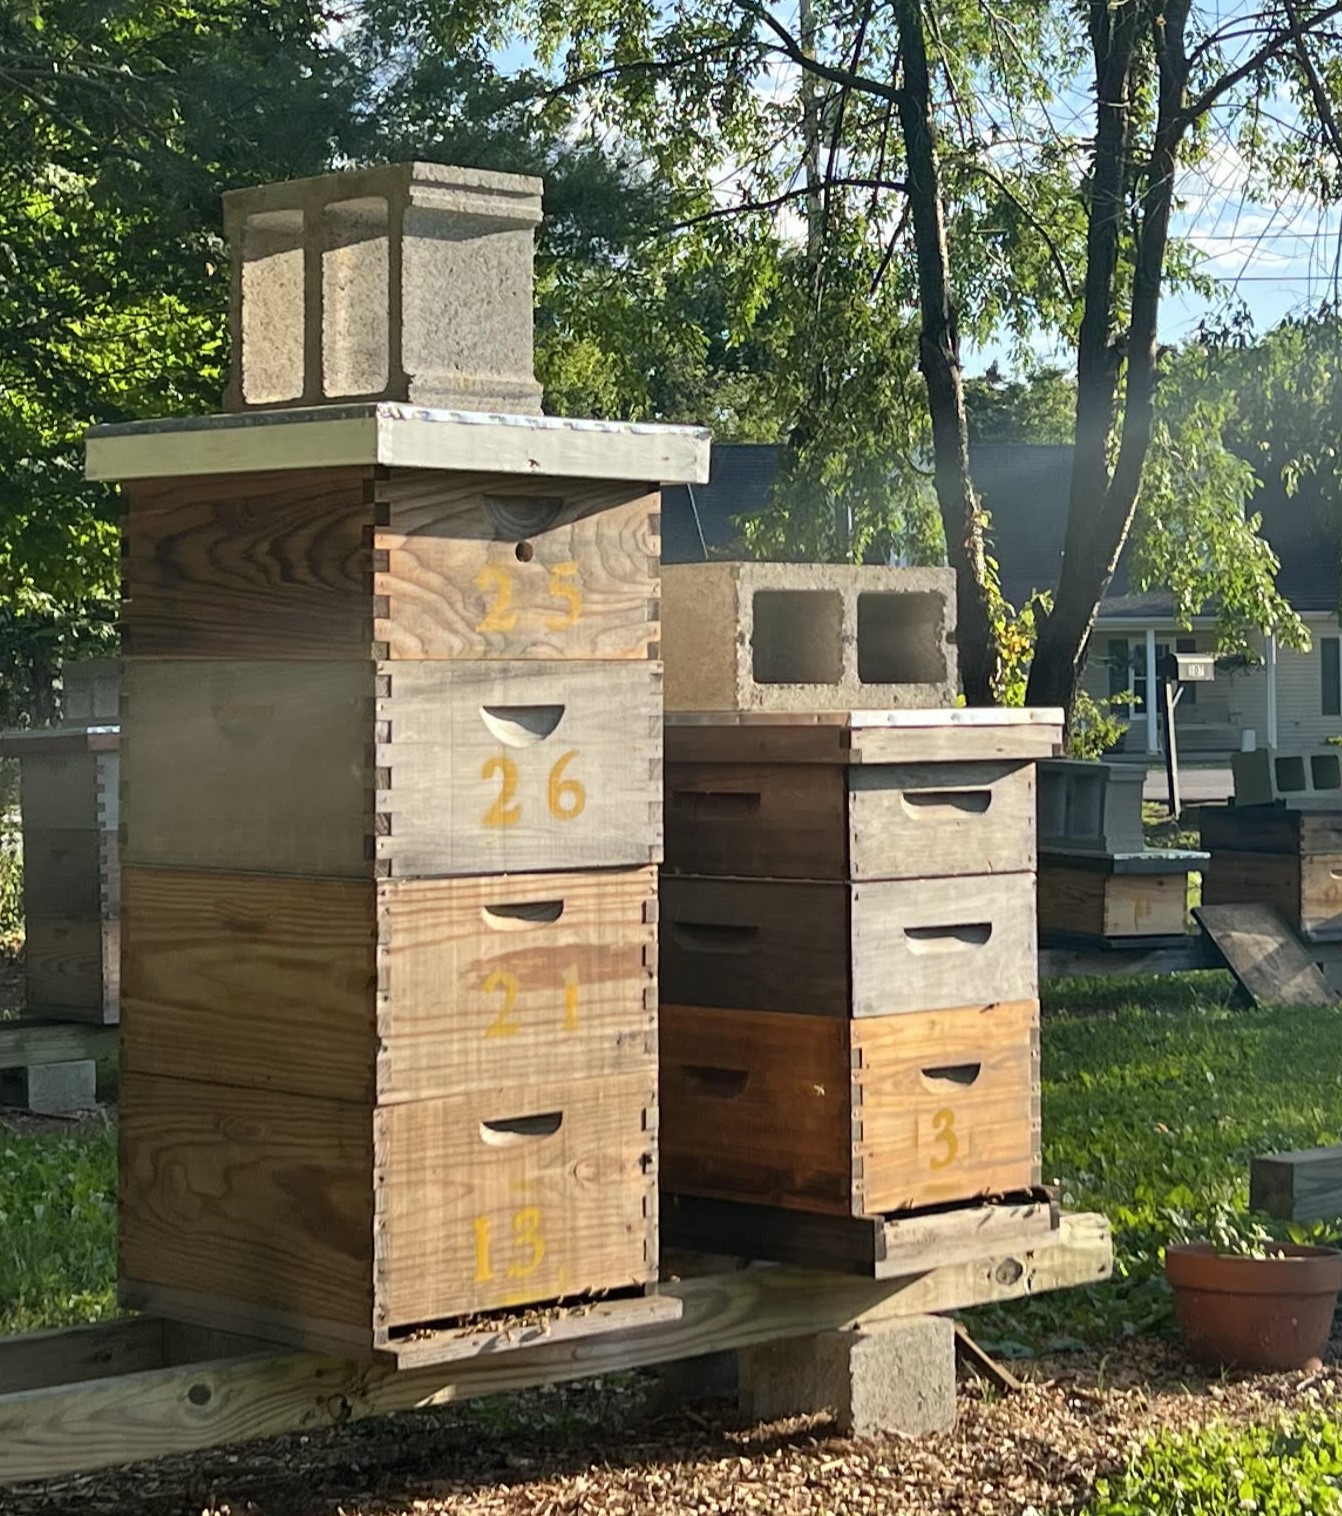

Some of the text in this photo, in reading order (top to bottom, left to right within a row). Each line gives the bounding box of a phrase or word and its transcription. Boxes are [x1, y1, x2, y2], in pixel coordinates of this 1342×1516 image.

[474, 561, 583, 633] 25
[480, 750, 586, 826] 26
[482, 965, 580, 1038] 21
[929, 1107, 959, 1172] 3
[472, 1205, 546, 1283] 13
